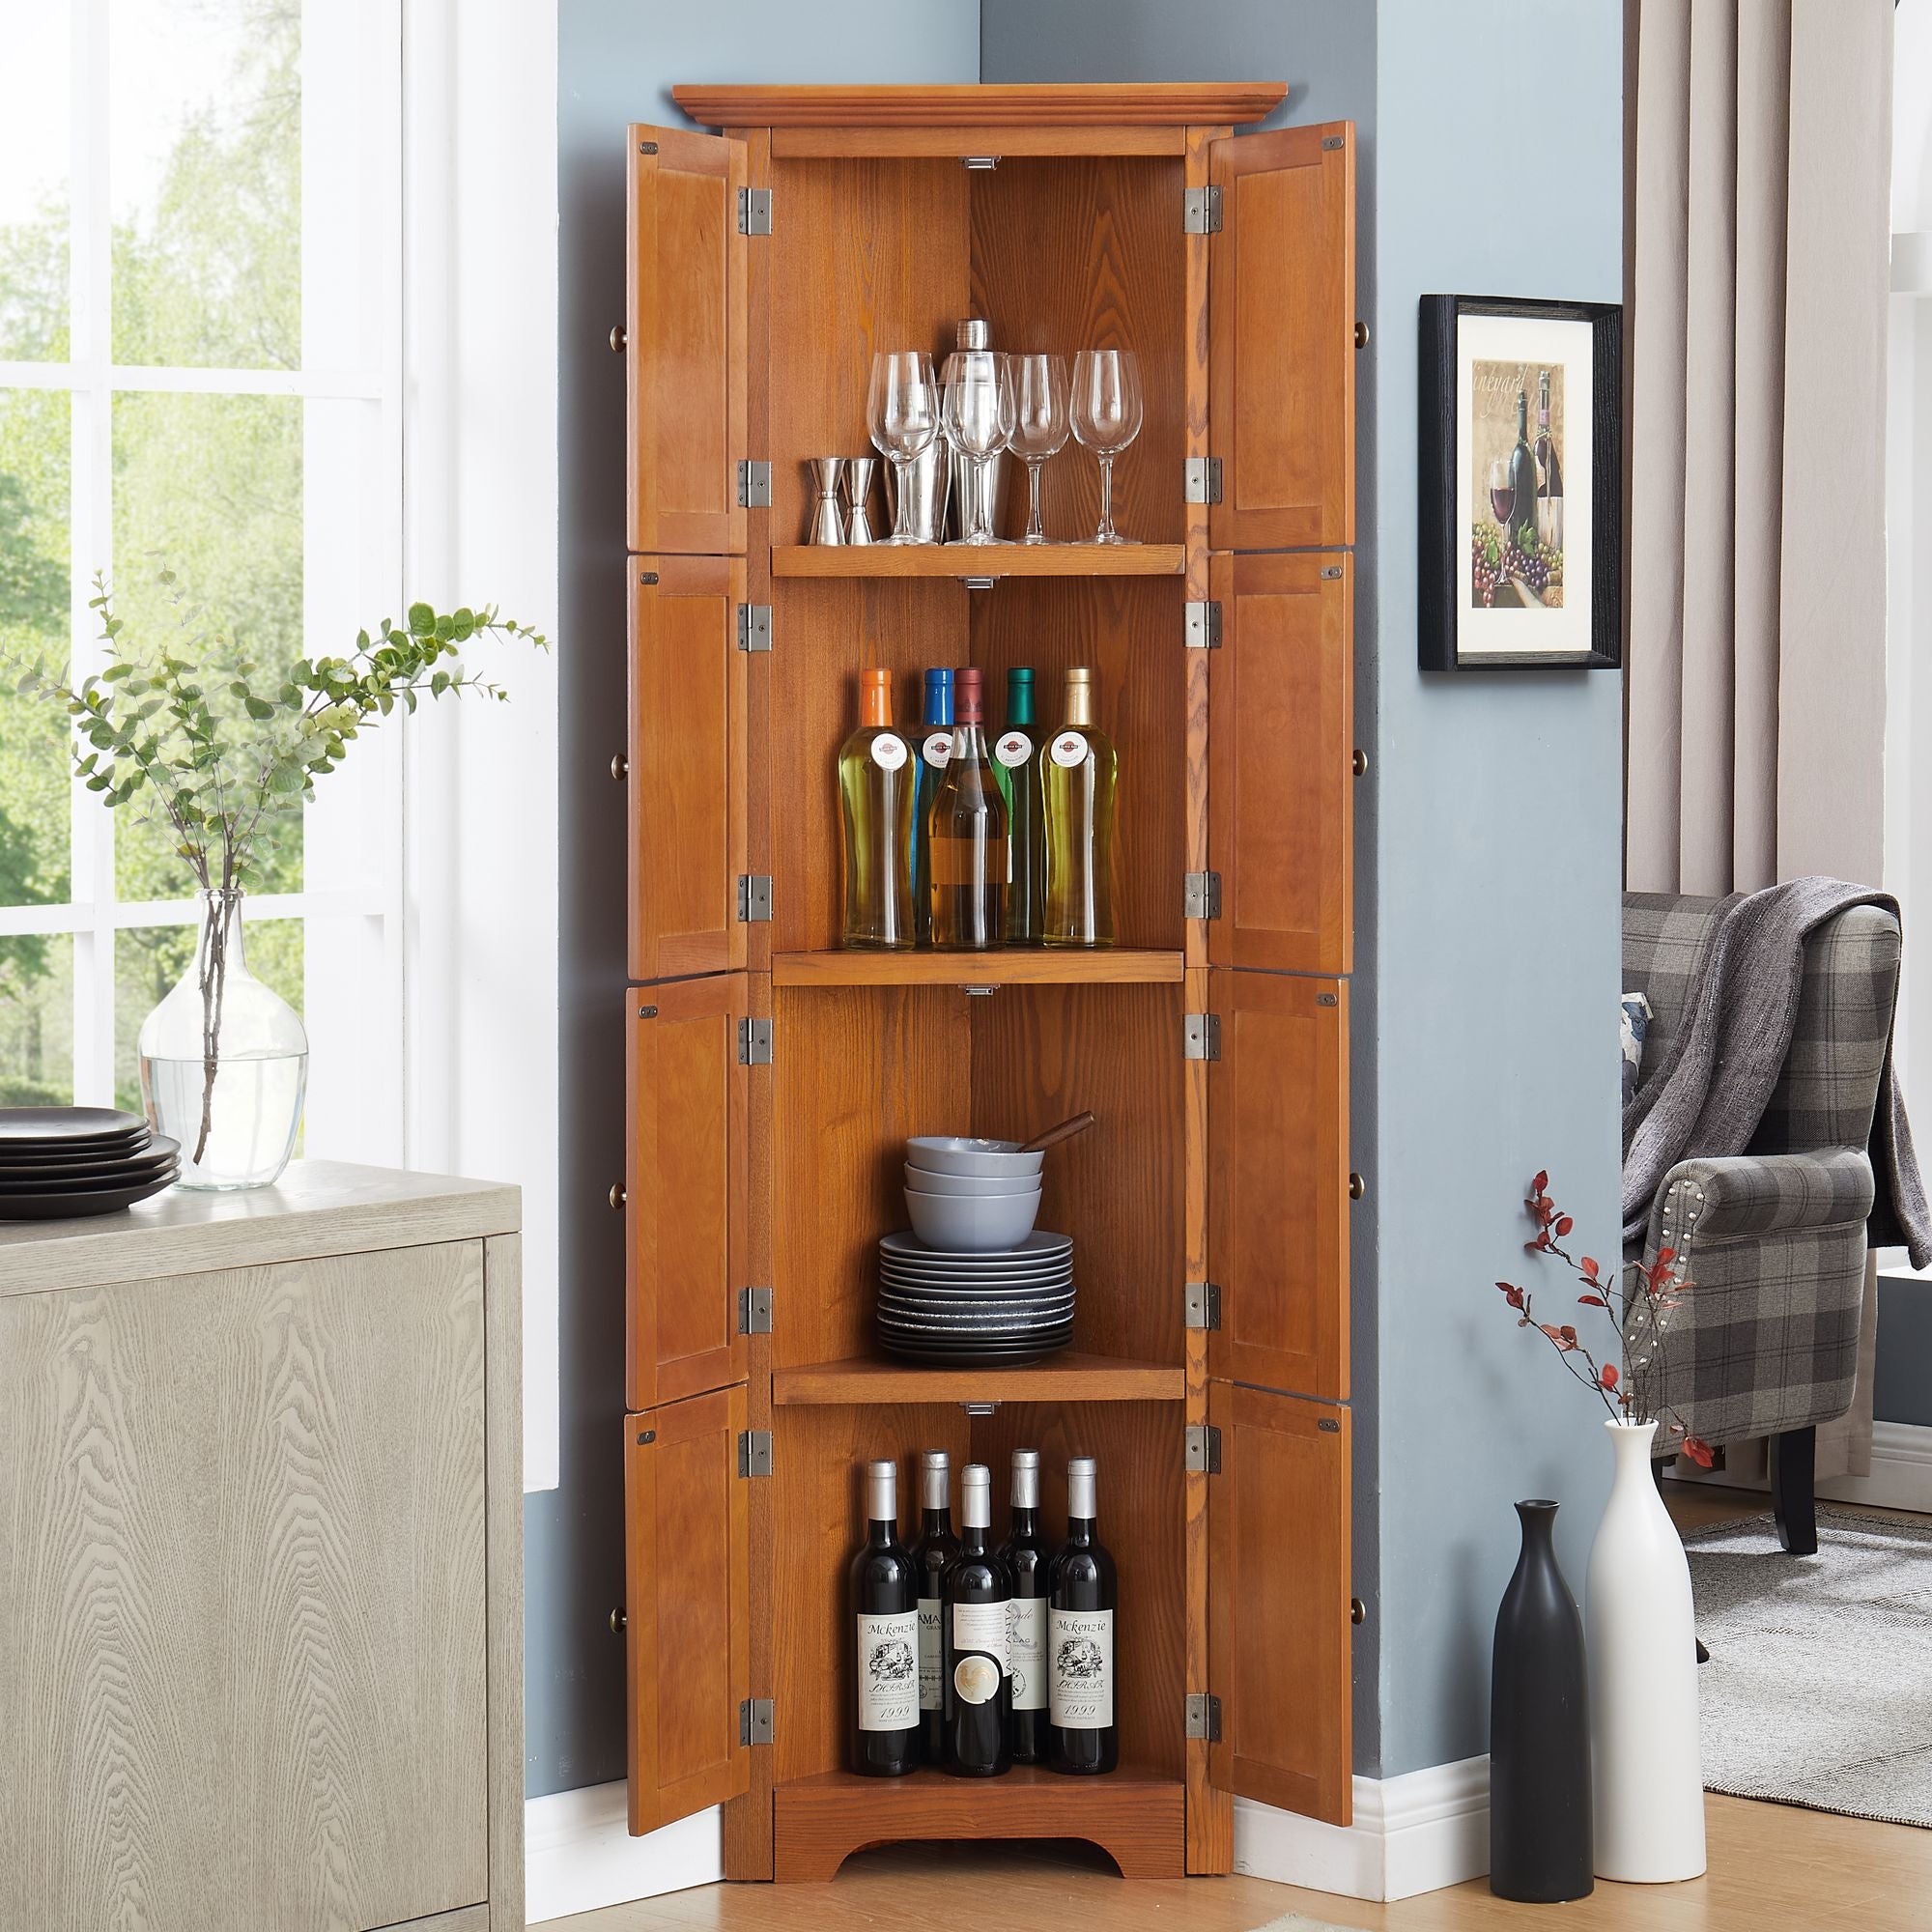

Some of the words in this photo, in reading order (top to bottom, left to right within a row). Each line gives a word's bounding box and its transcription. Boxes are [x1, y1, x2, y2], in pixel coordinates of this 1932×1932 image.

[867, 1620, 916, 1636] Mckenzie
[1056, 1619, 1106, 1634] Mckenzie
[880, 1705, 910, 1719] 1999
[1065, 1704, 1096, 1716] 1999
